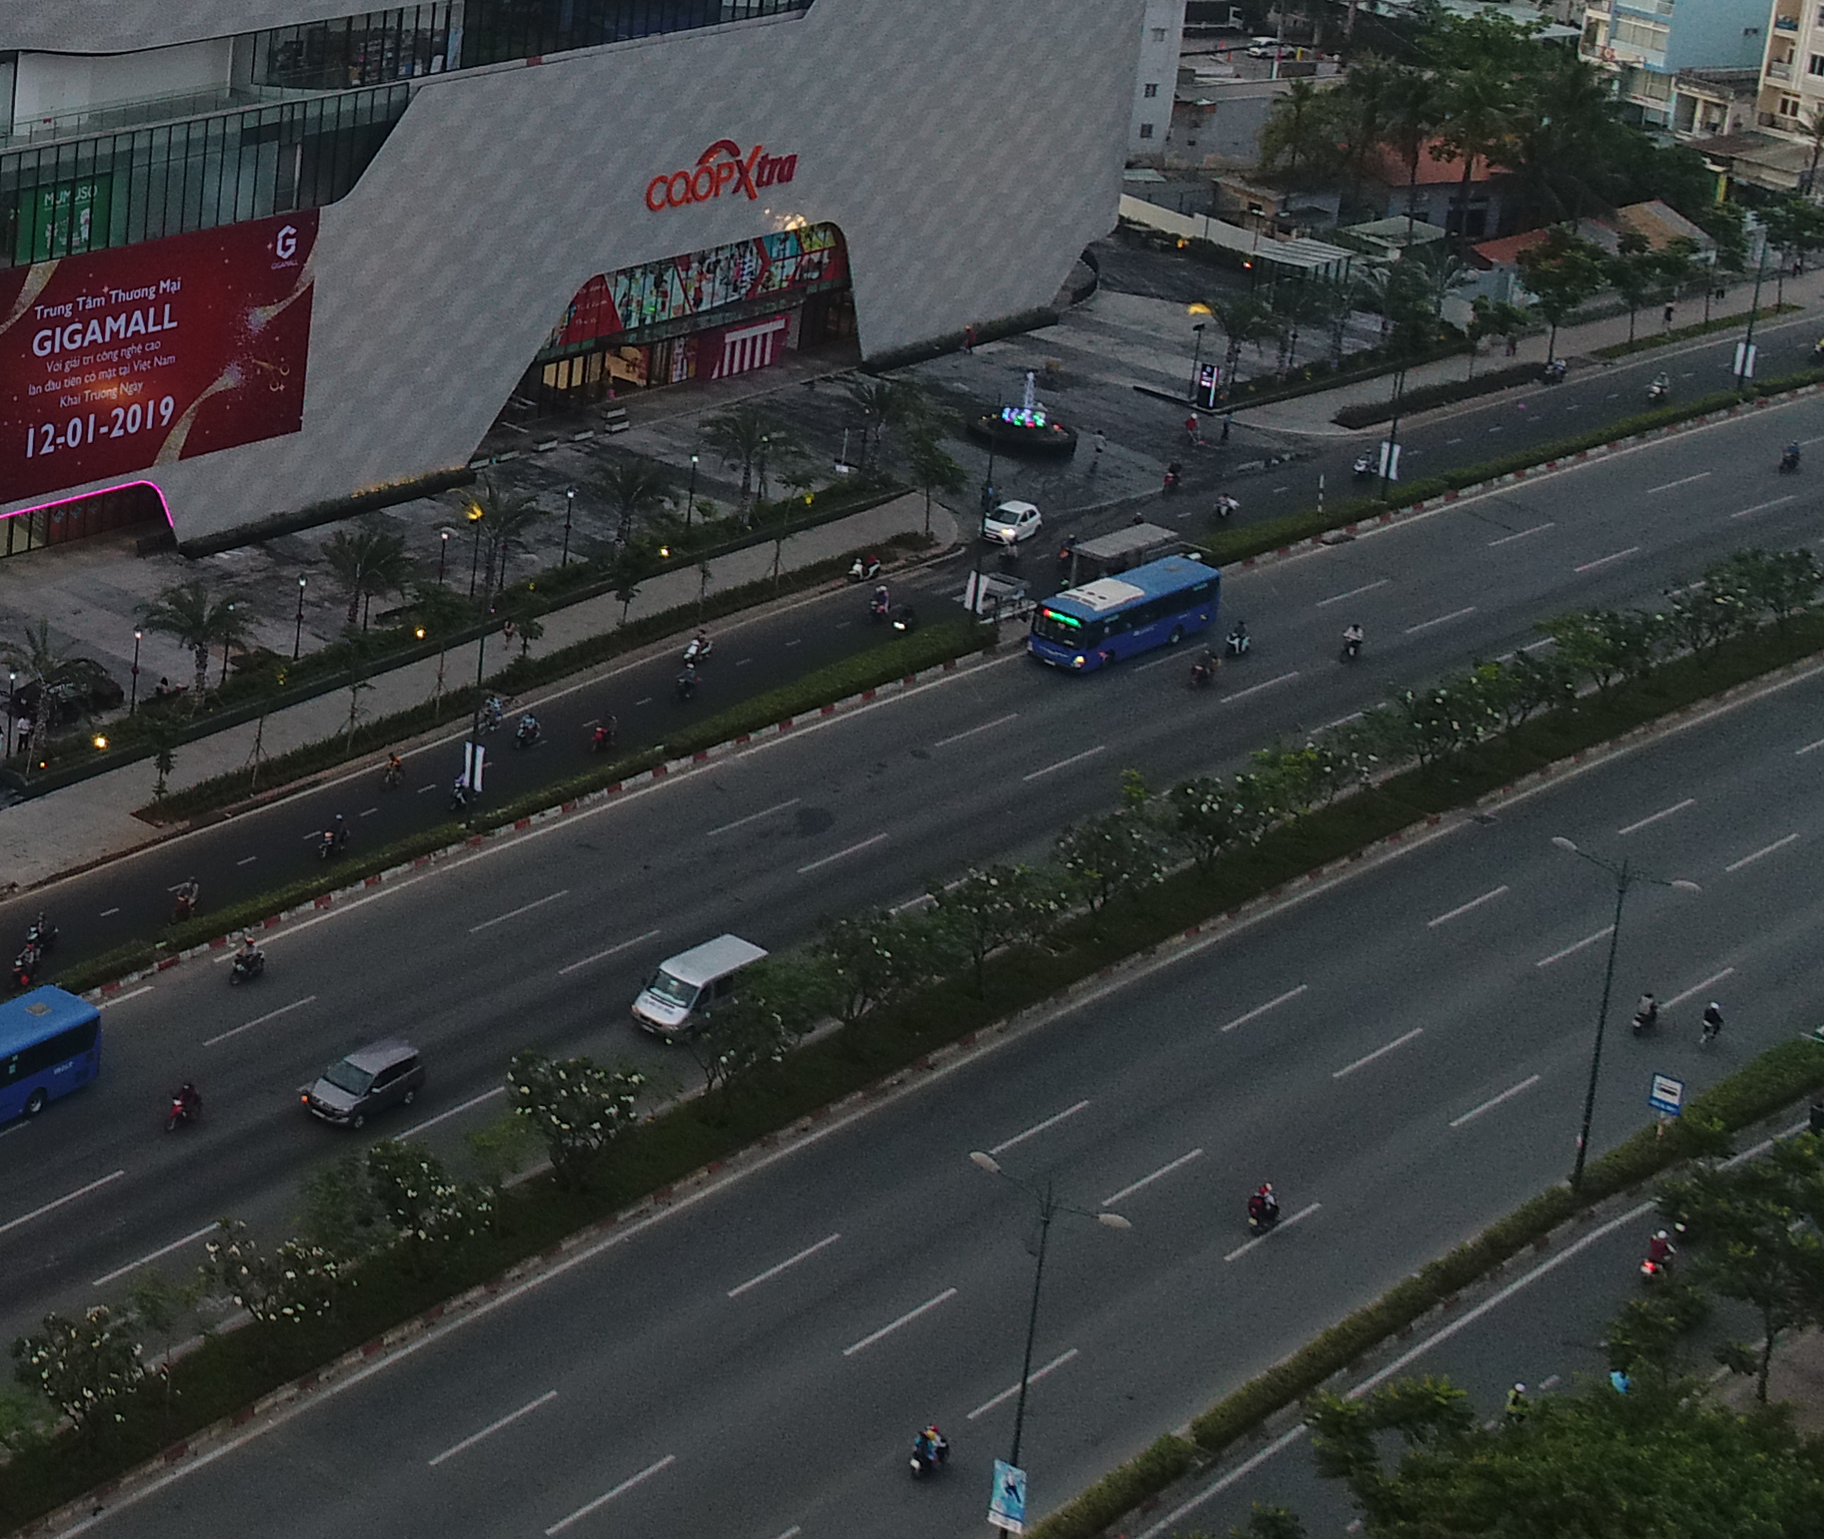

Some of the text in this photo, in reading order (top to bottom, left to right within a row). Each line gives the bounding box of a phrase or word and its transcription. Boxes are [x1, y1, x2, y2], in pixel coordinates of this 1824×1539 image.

[34, 277, 181, 319] Trung Tâm Thương Mại
[32, 303, 178, 357] GIGAMALL
[96, 348, 119, 363] công
[120, 342, 142, 357] nghệ
[145, 340, 161, 351] cao
[133, 359, 151, 373] Việt
[153, 354, 176, 366] Nam
[60, 393, 81, 408] Khai
[26, 395, 175, 458] 12-01-2019
